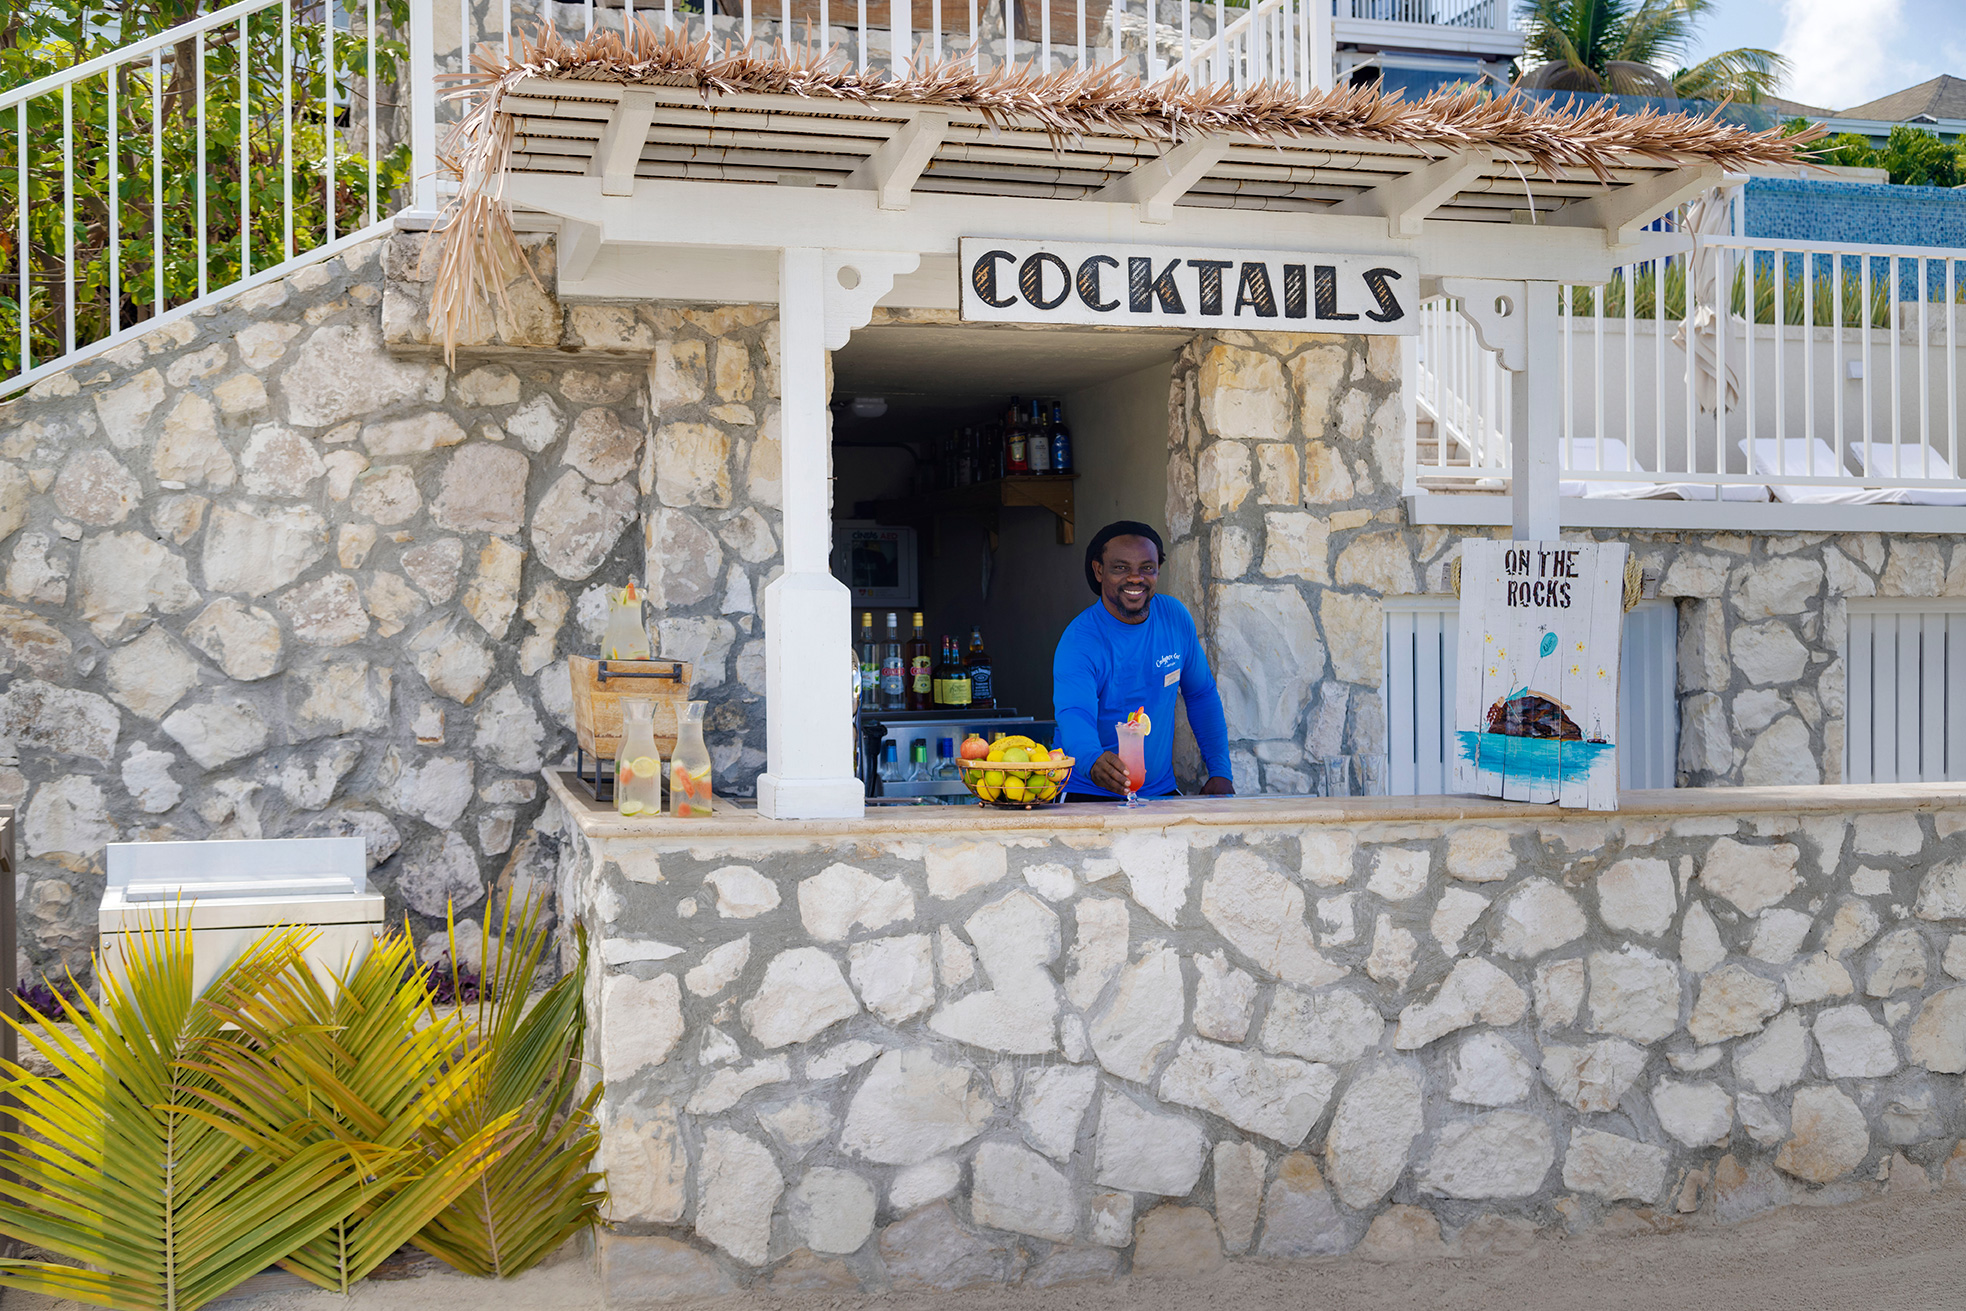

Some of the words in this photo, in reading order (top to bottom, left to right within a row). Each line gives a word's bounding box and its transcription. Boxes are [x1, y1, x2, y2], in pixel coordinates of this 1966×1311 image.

[971, 249, 1405, 323] COCKTAILS
[880, 532, 898, 540] AED
[1504, 549, 1531, 577] ON
[1538, 549, 1581, 578] THE
[1507, 580, 1572, 609] ROCKS
